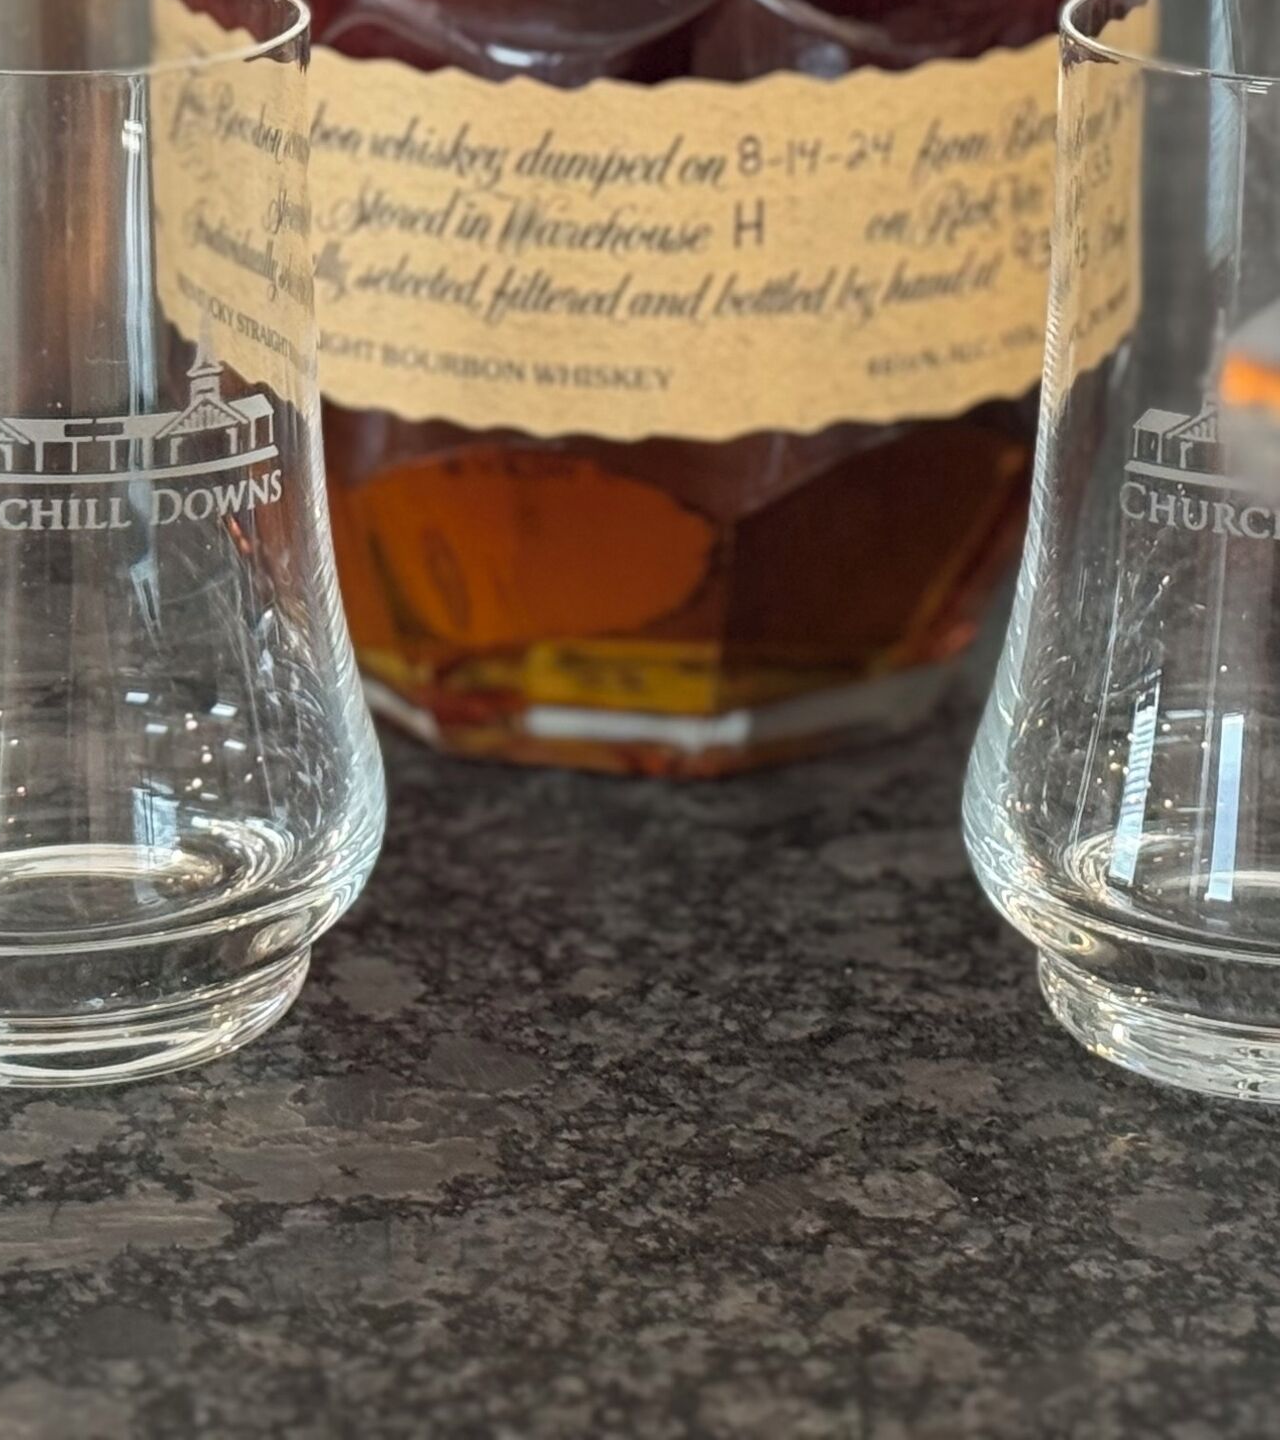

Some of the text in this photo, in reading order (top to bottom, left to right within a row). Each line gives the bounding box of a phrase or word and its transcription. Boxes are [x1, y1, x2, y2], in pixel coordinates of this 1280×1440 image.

[514, 128, 683, 197] dumped
[678, 152, 726, 187] on
[736, 129, 896, 177] 8-14-24
[454, 200, 492, 243] in
[496, 188, 712, 257] Warehouse
[733, 197, 766, 249] H
[626, 272, 714, 324] and
[711, 267, 837, 320] bottled
[834, 265, 880, 330] by
[380, 340, 526, 384] BOURBON
[532, 357, 676, 393] WHISKEY
[150, 467, 284, 527] DOWNS
